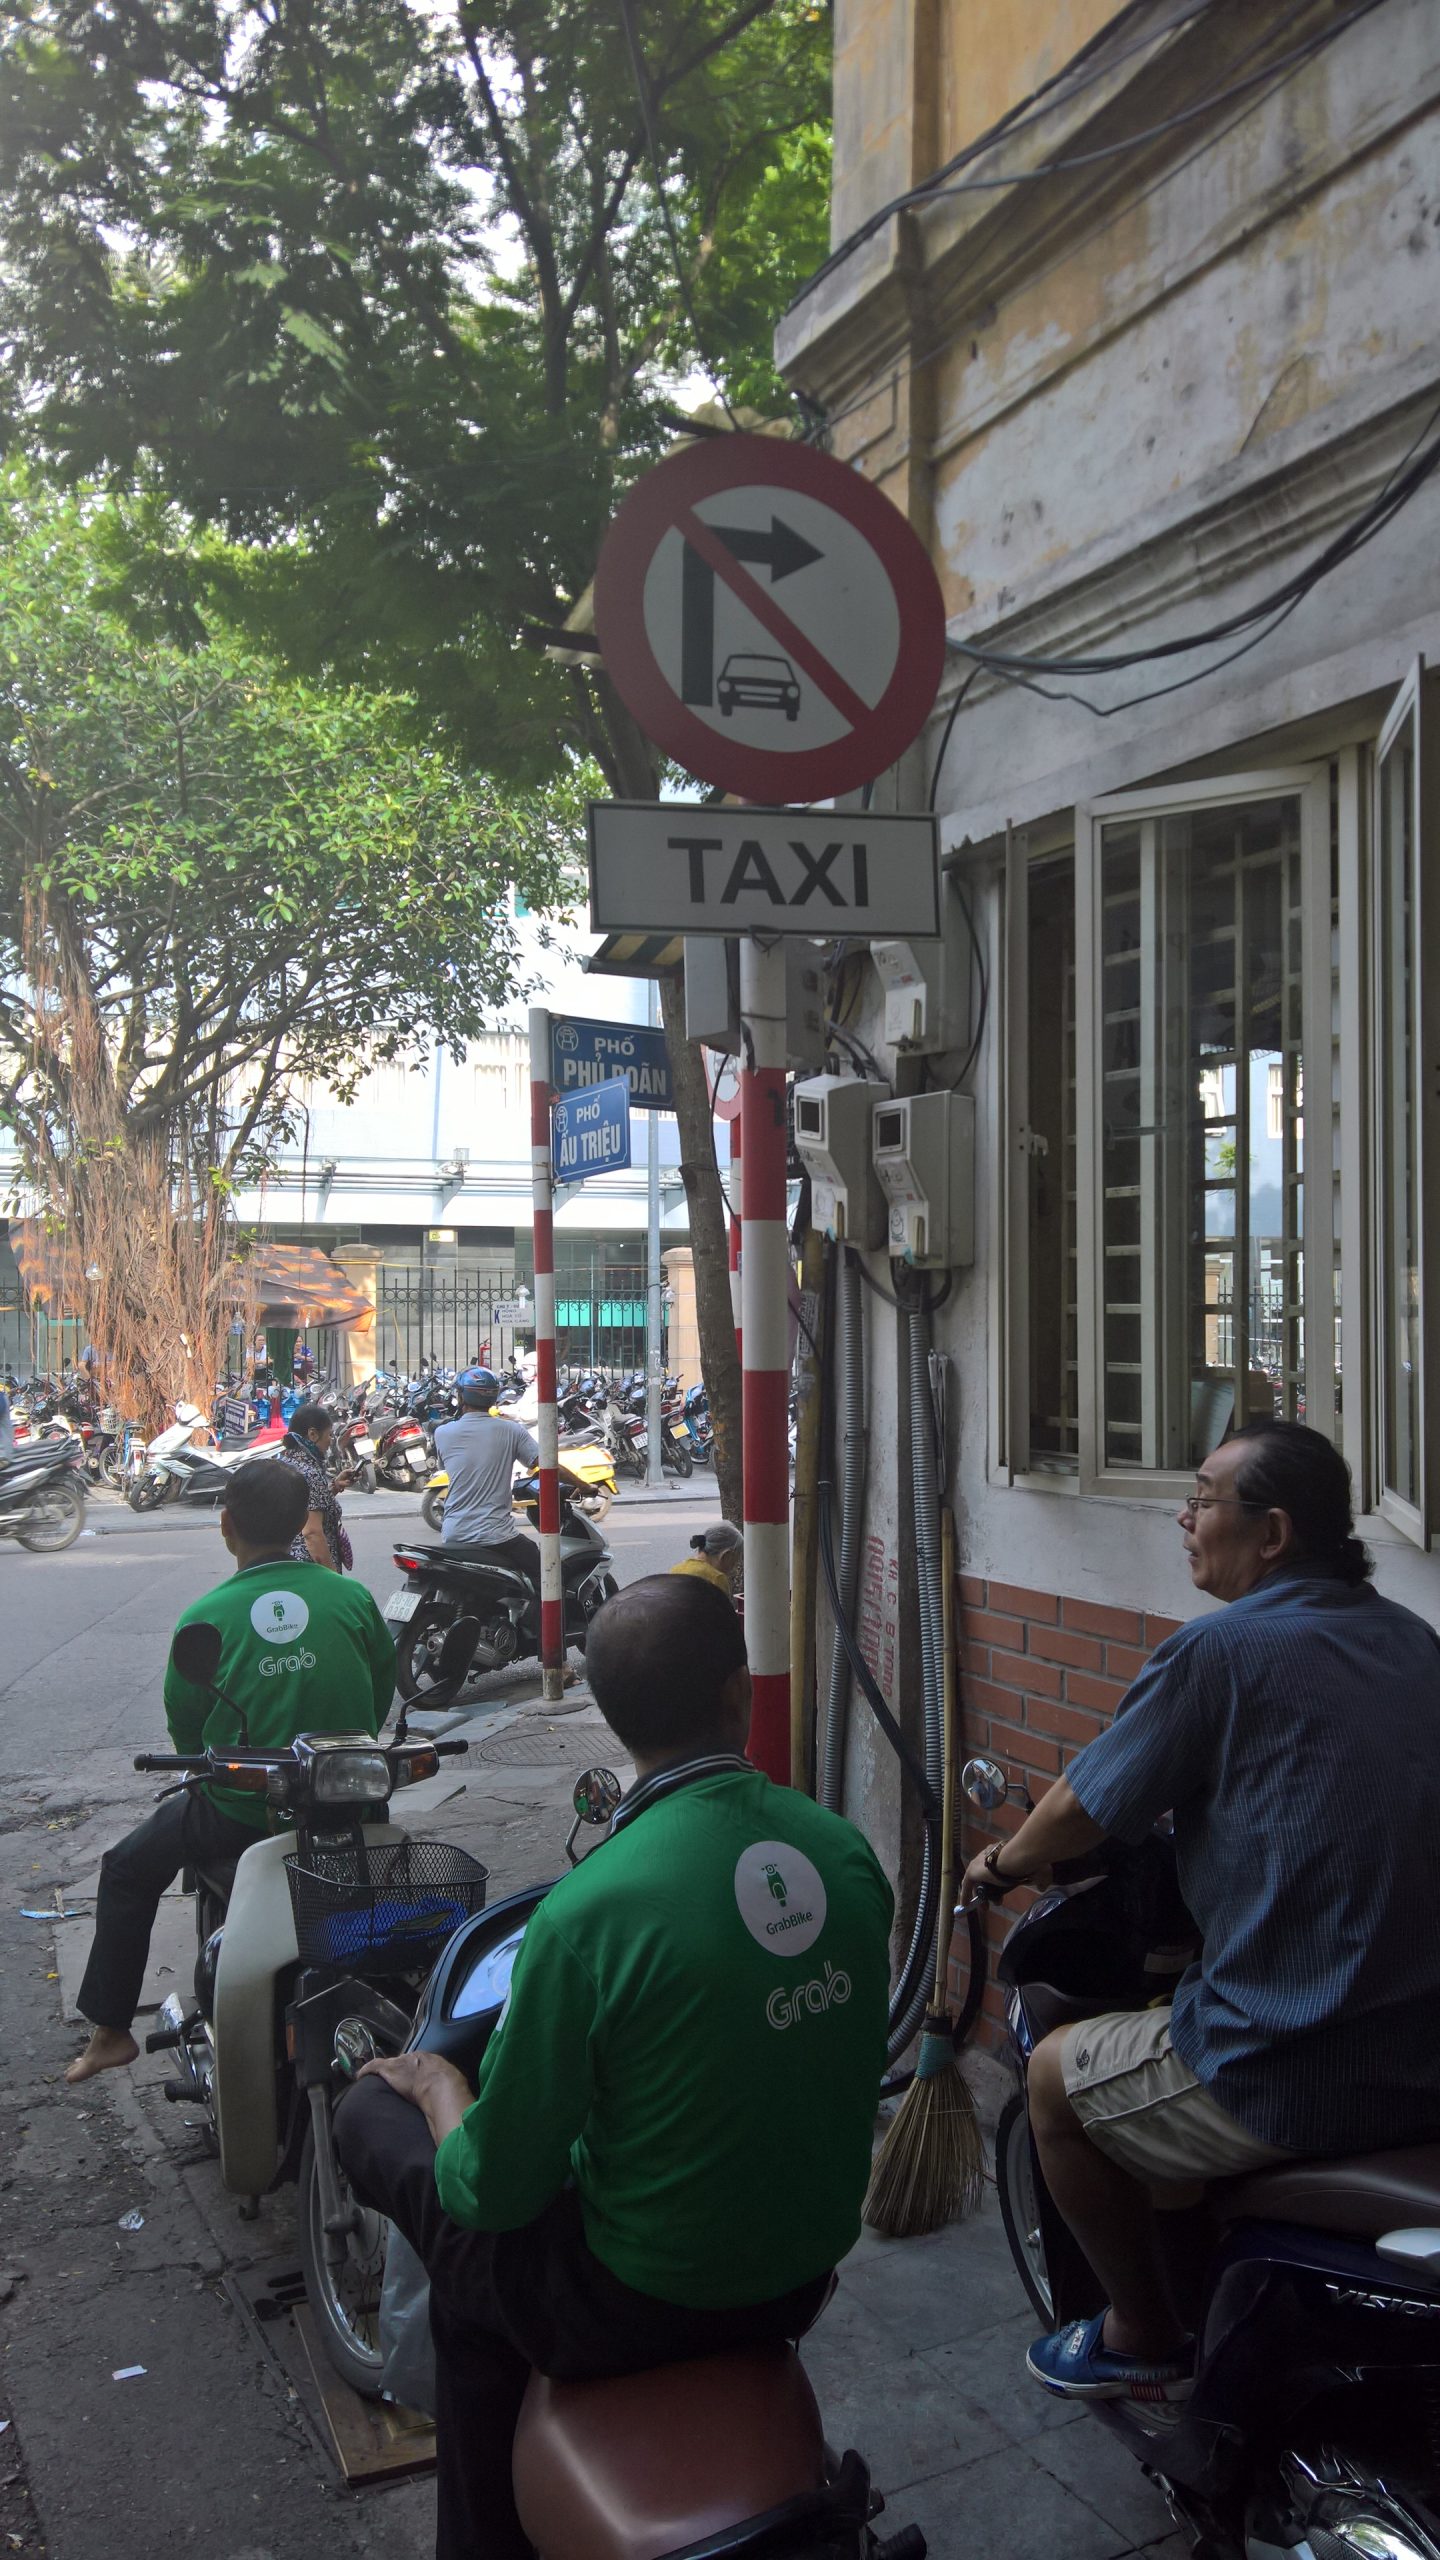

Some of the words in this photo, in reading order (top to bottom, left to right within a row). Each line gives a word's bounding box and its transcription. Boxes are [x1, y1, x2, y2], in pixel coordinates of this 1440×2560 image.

[667, 837, 870, 908] TAXI
[594, 1035, 635, 1056] PHỐ
[576, 1095, 600, 1124] PHỐ
[559, 1129, 577, 1167] ẤU
[581, 1120, 621, 1162] TRIỆU
[266, 1623, 298, 1634] GrabBike
[258, 1646, 316, 1677] Grab
[766, 1911, 813, 1935] GrabBike
[765, 1959, 851, 2030] Grab
